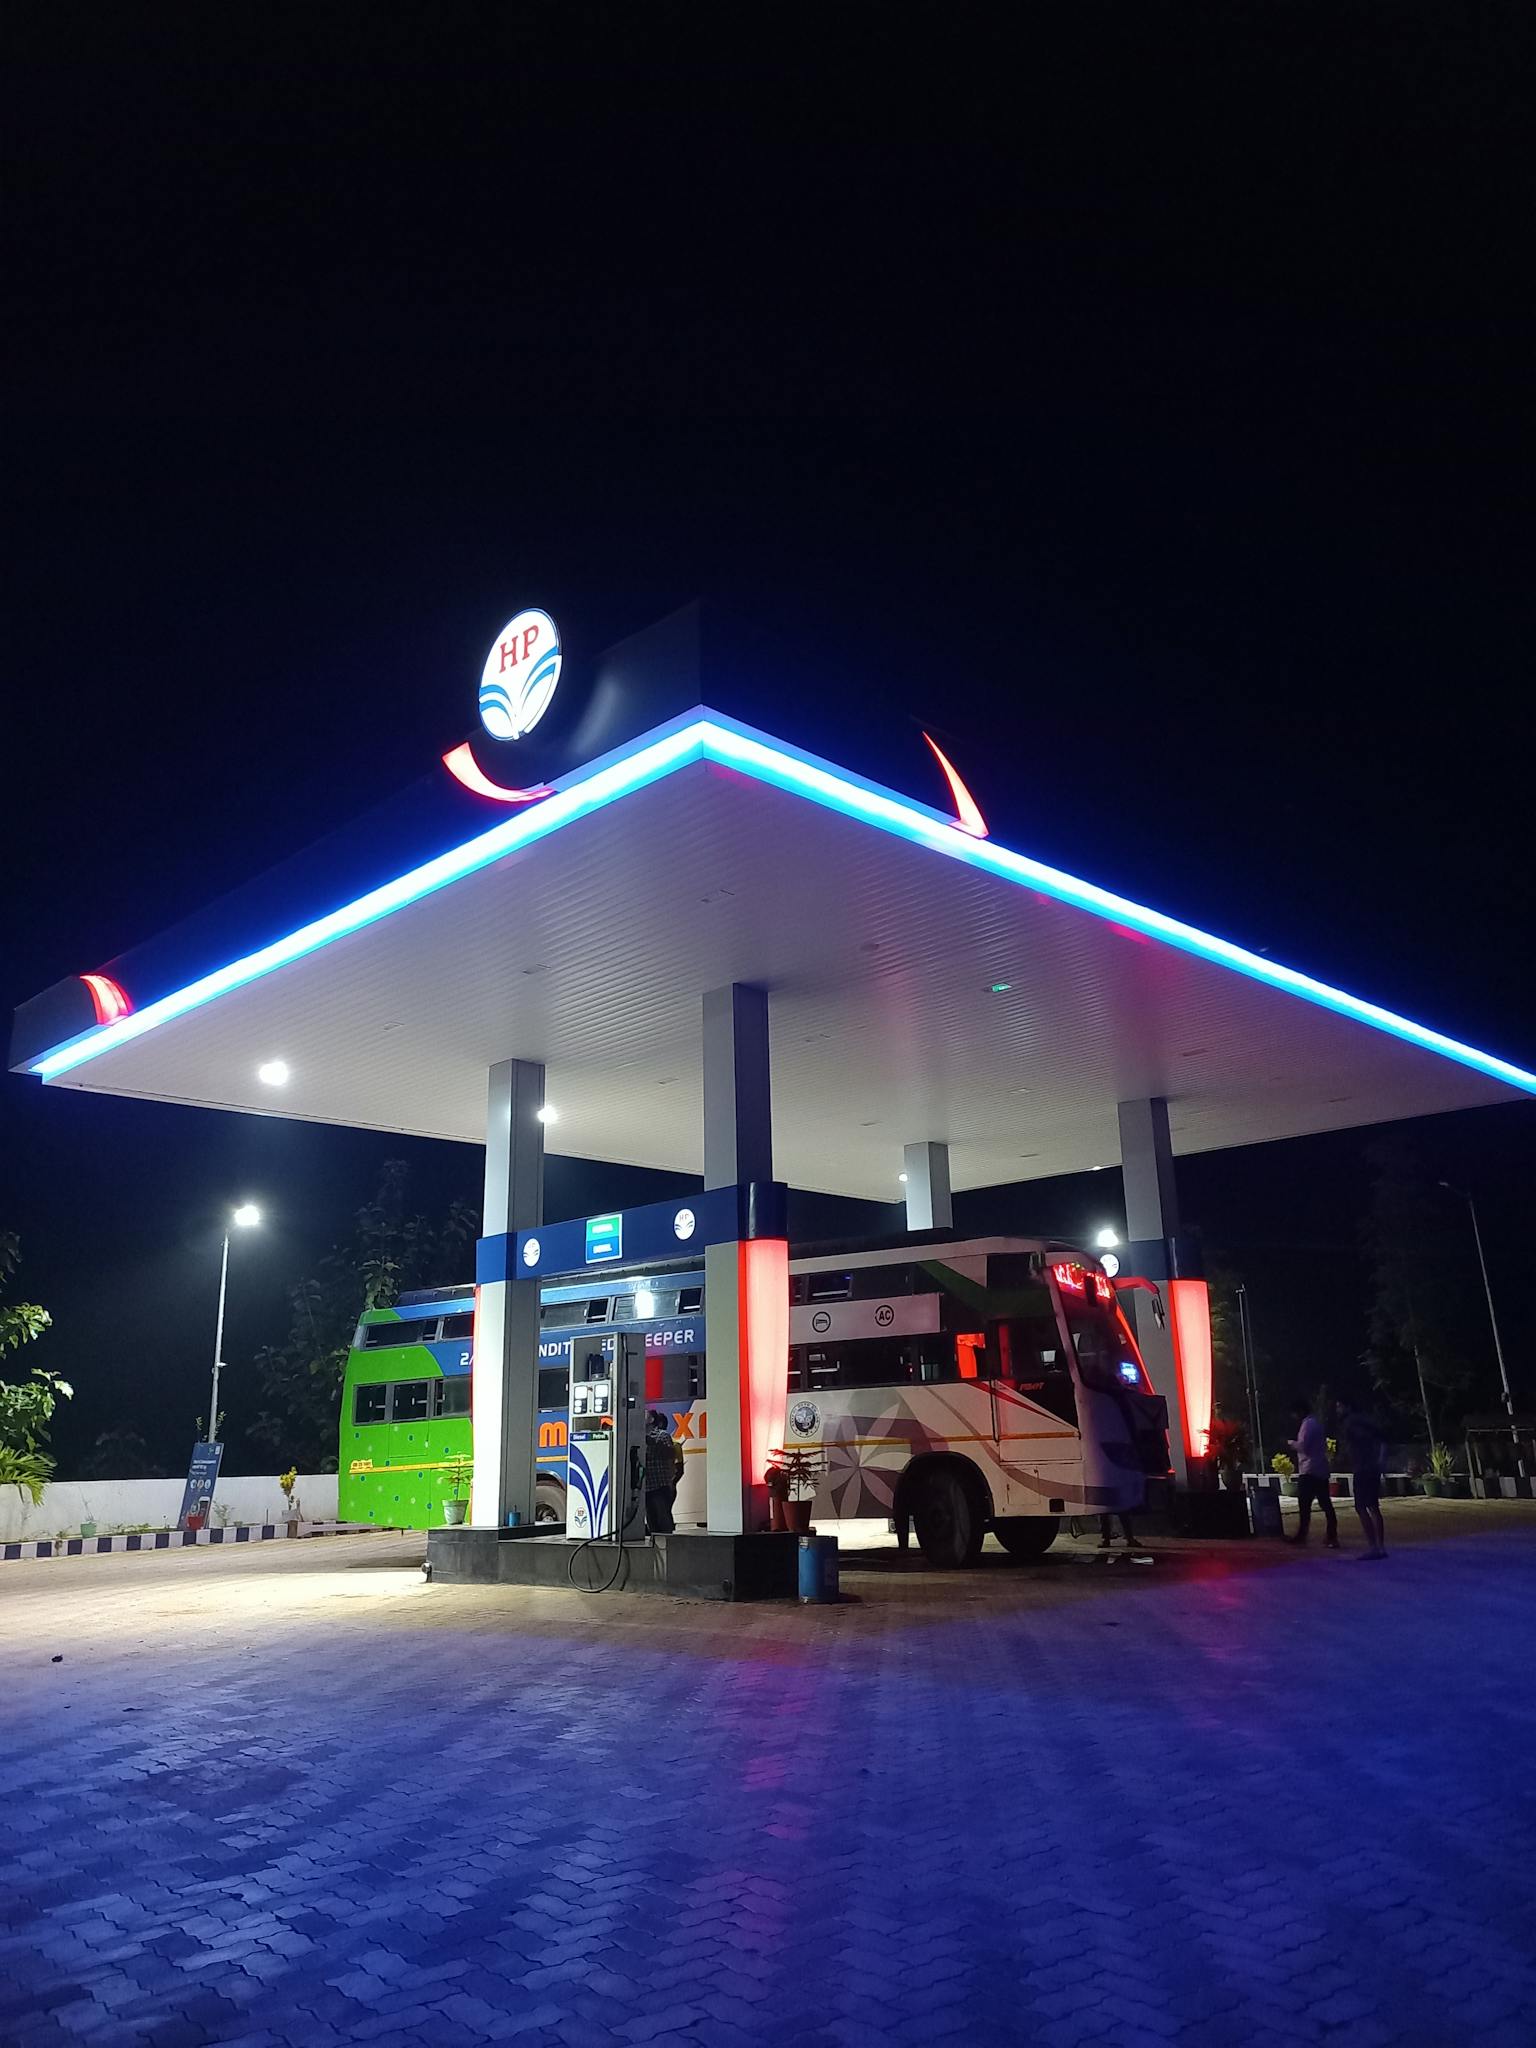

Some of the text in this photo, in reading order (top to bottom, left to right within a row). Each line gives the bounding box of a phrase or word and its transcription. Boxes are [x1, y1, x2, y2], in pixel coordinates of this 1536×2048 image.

[498, 623, 540, 674] HP
[878, 1310, 891, 1321] AC
[645, 1329, 695, 1347] EEPER
